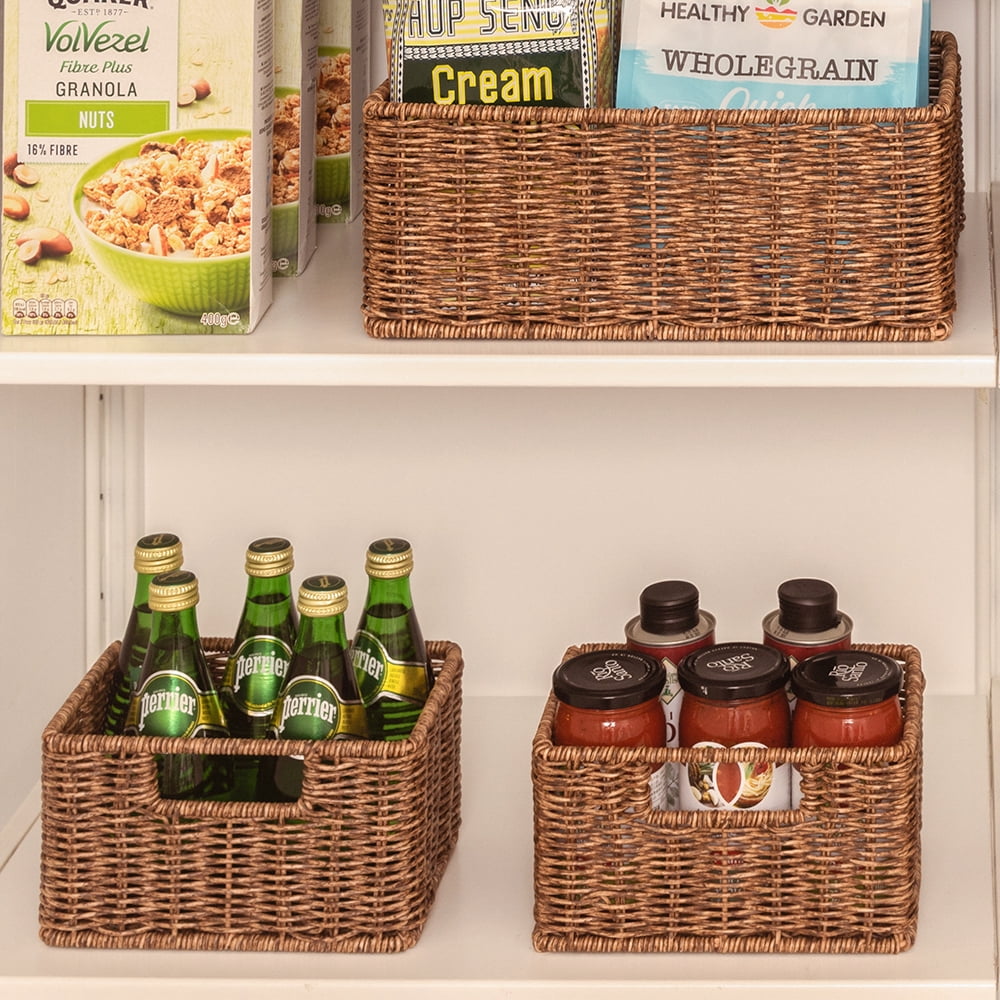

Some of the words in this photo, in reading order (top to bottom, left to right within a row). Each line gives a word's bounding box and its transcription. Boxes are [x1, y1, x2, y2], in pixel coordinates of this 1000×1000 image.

[660, 2, 750, 23] HEALTHY
[803, 9, 886, 28] GARDEN
[44, 20, 150, 53] VolVezel
[60, 60, 98, 73] Fibre
[102, 60, 132, 73] Plus
[662, 49, 879, 82] WHOLEGRAIN
[56, 82, 137, 97] GRANOLA
[432, 64, 553, 105] Cream
[79, 111, 114, 129] NUTS
[27, 144, 47, 155] 16%
[50, 144, 78, 156] FIBRE
